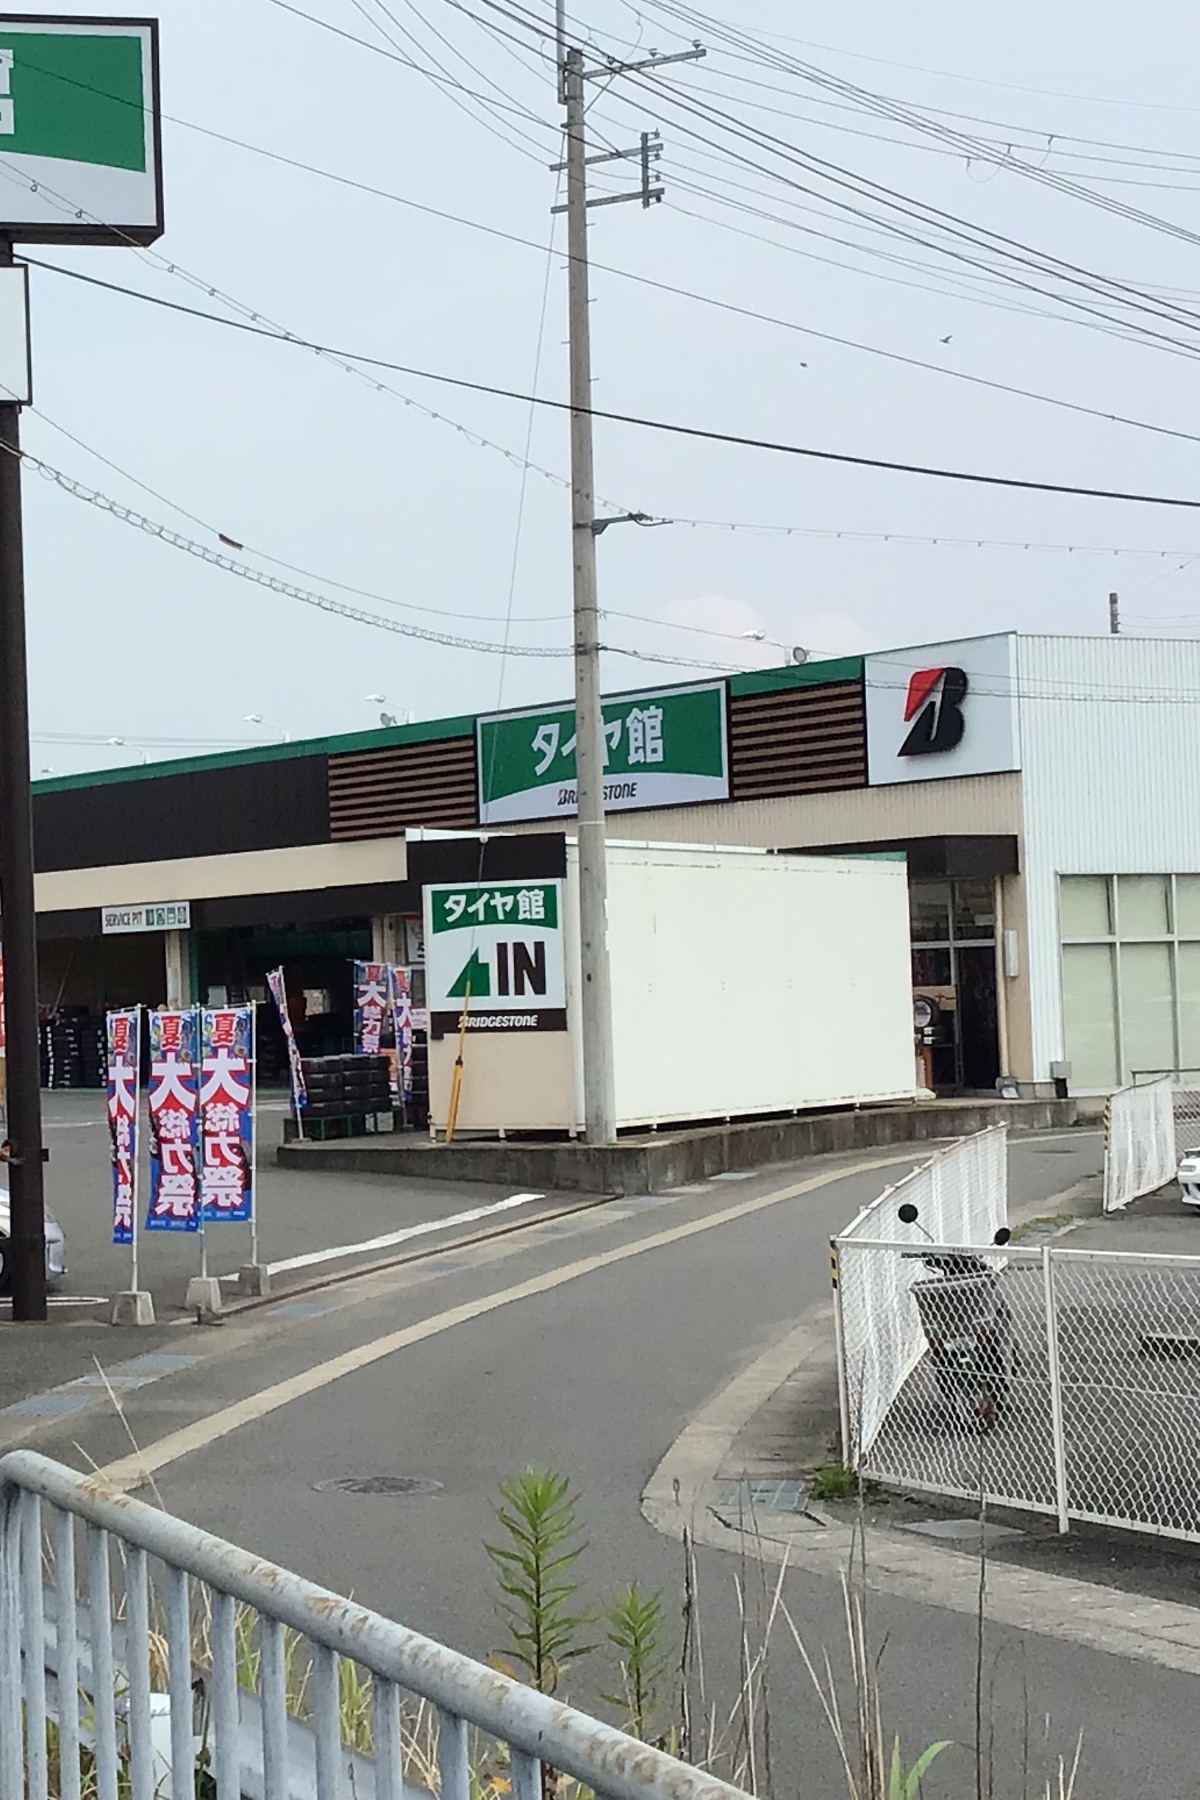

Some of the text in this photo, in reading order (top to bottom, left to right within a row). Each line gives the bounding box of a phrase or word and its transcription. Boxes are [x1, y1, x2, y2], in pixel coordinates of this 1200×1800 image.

[557, 782, 638, 806] BRSTONE
[443, 888, 545, 923] タイヤ館
[105, 911, 143, 928] SERVICE PIT
[496, 941, 546, 996] IN
[457, 1014, 539, 1029] BRIDGESTONE
